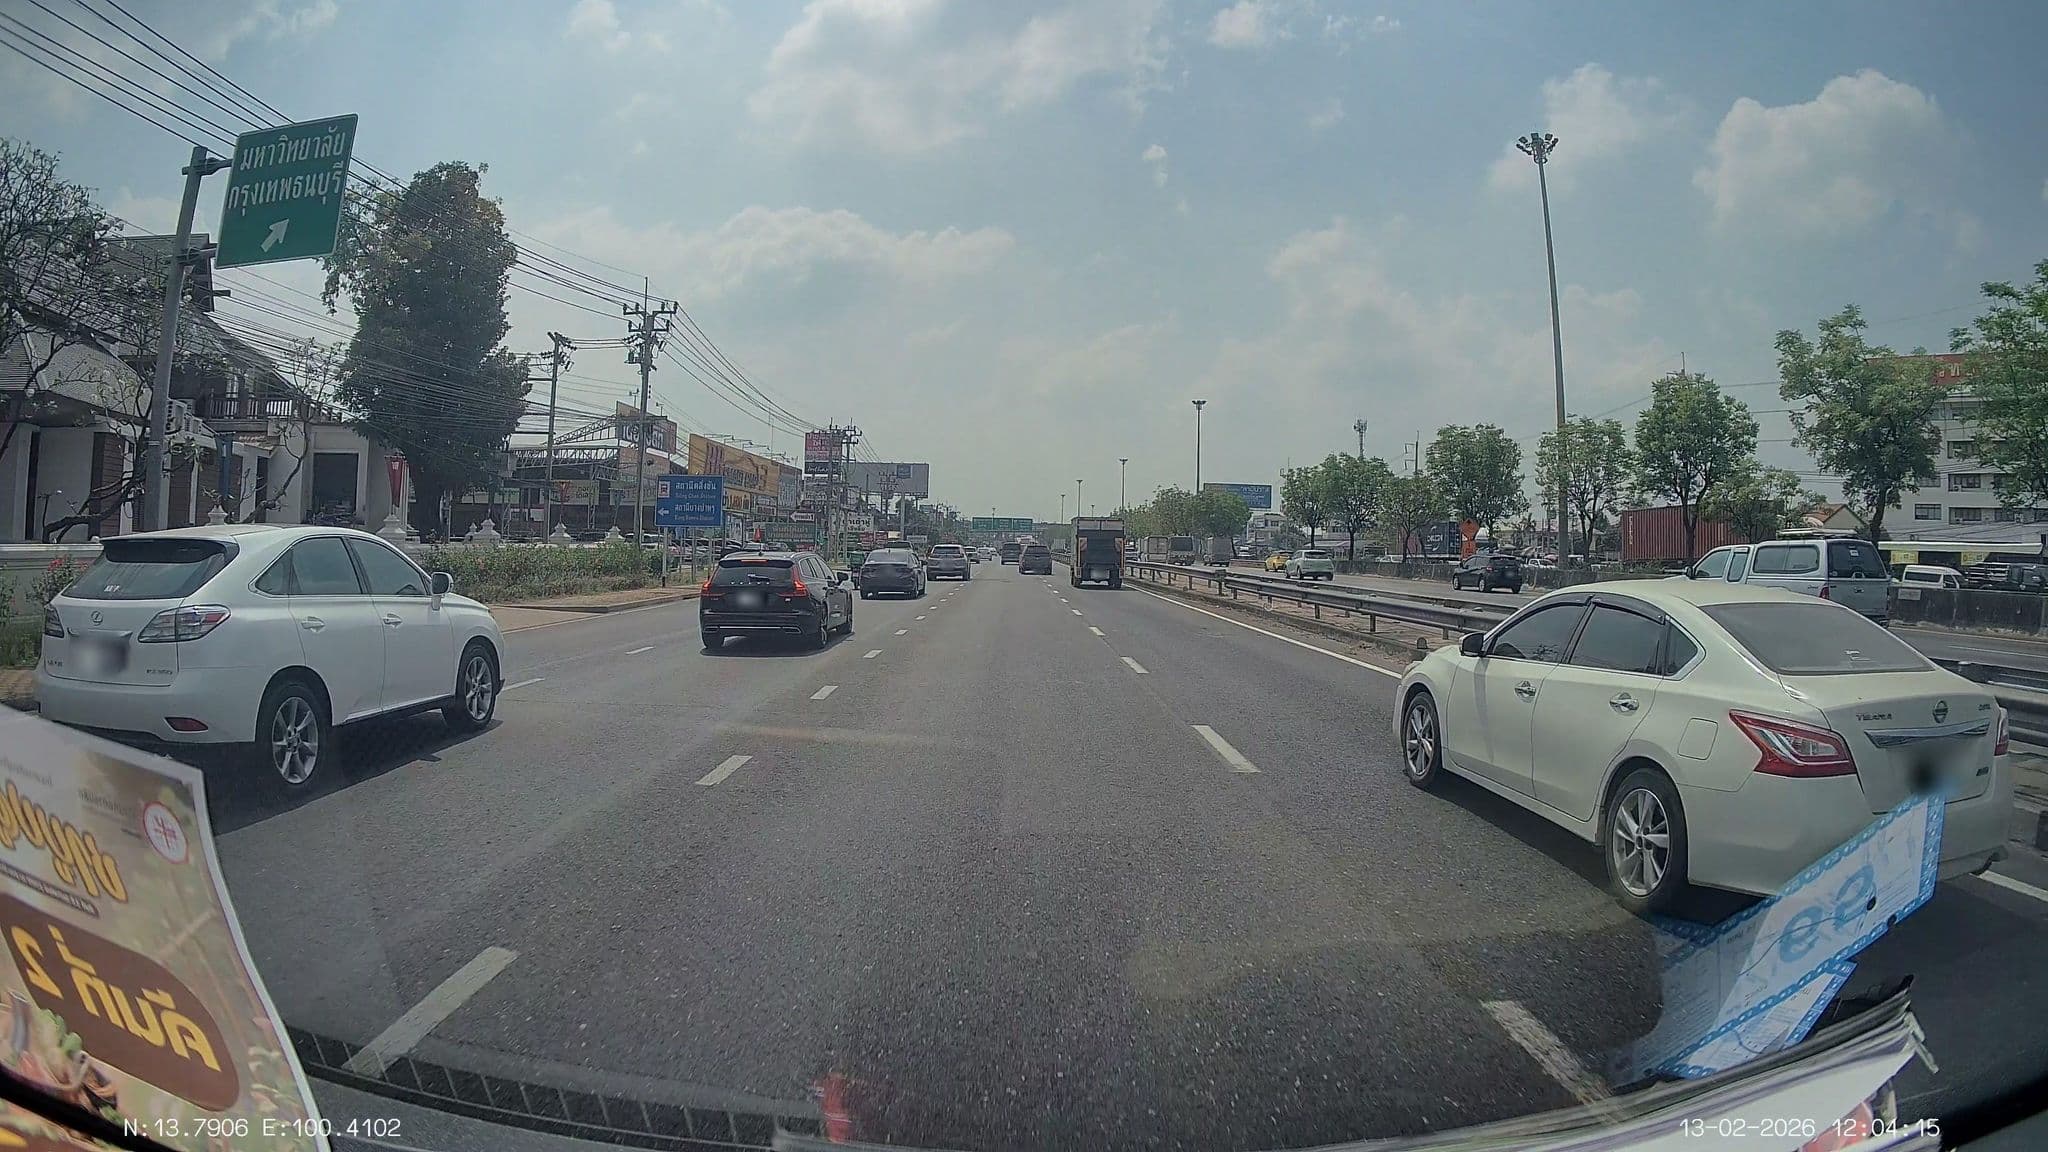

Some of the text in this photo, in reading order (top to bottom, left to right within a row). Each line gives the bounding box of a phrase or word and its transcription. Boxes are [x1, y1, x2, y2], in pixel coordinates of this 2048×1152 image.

[239, 126, 346, 171] มหาวิทยาลัย
[226, 160, 344, 217] กรุงเทพธนบุรี
[675, 479, 717, 490] สถานีตลิ่งชัน
